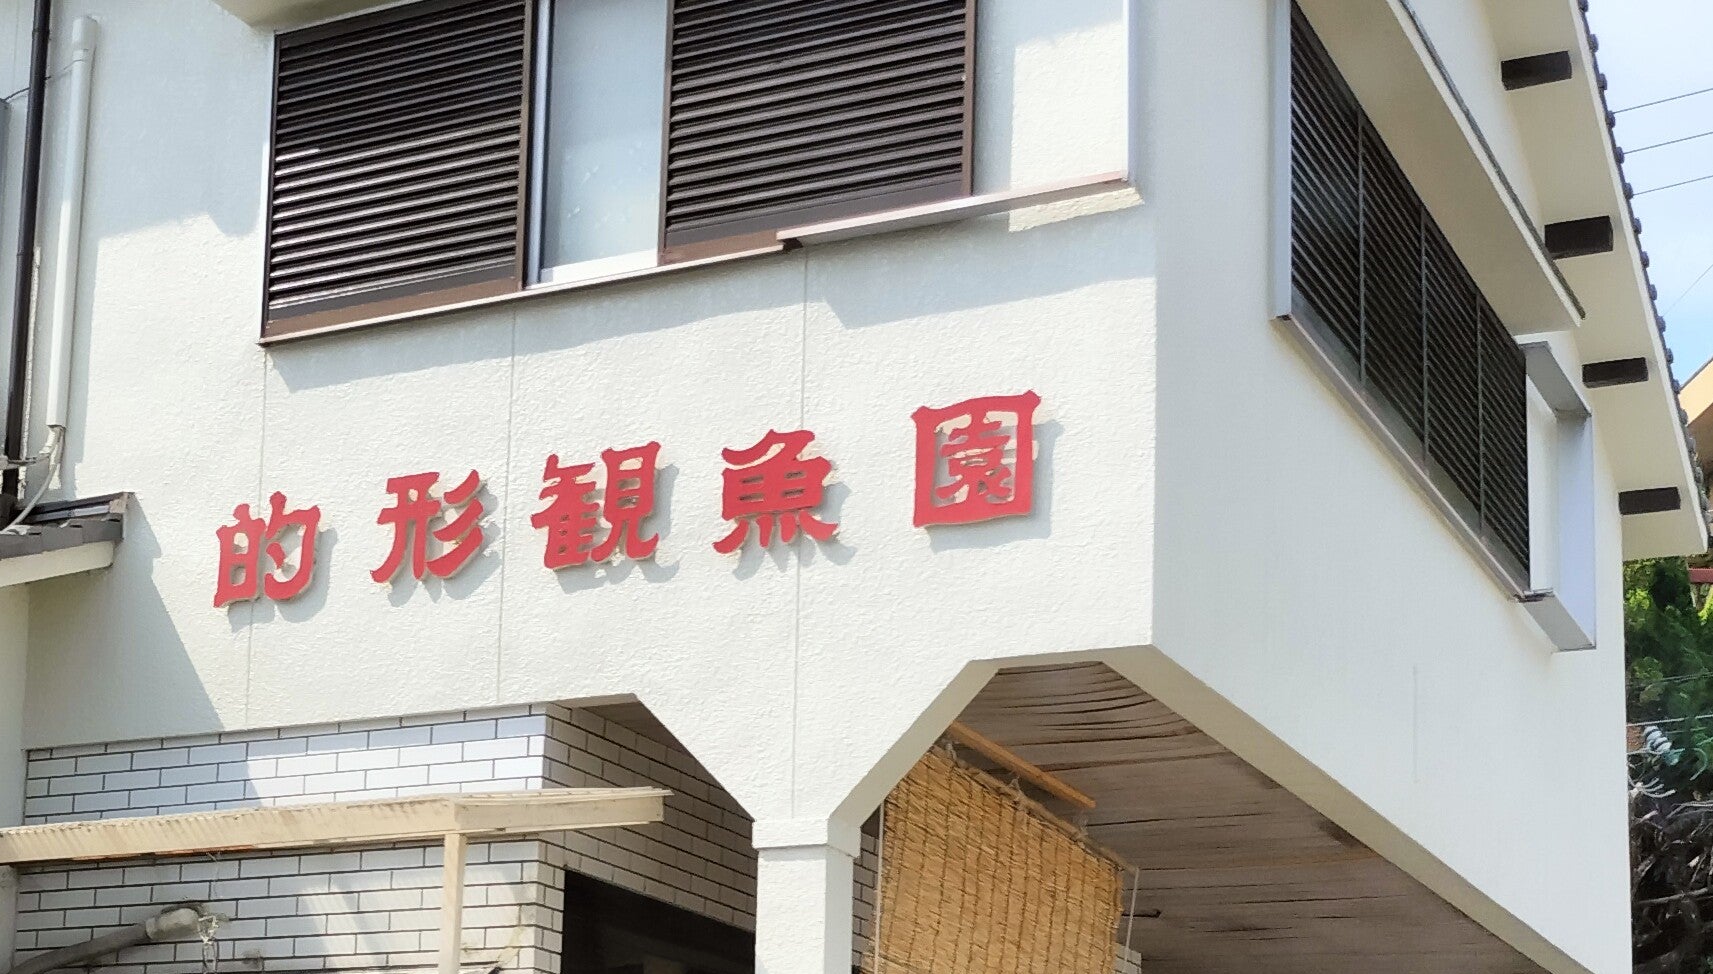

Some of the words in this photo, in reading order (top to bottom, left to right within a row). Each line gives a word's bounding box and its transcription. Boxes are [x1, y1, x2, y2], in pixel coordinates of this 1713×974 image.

[213, 390, 1042, 608] 的形観魚園
